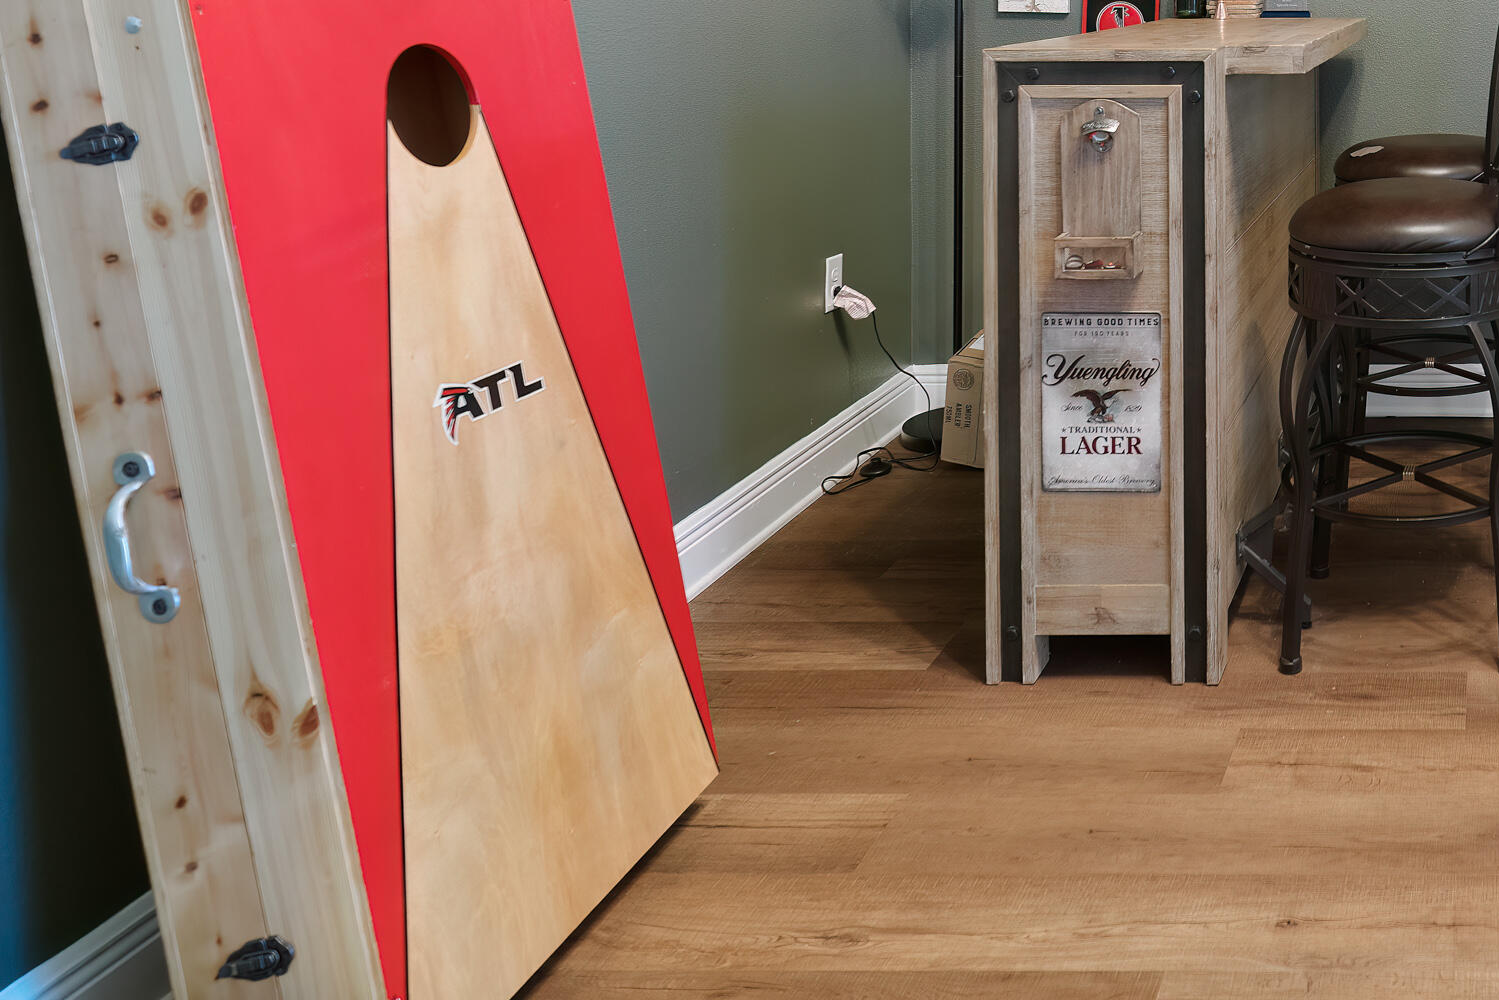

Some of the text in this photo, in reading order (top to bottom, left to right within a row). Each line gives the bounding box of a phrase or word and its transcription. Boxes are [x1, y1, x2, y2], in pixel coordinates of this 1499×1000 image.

[1043, 318, 1159, 326] BREWING GOOD TIMES
[1041, 354, 1161, 387] Yuengling
[436, 361, 545, 444] ATL
[1068, 426, 1136, 434] TRADITIONAL
[1060, 436, 1144, 455] LAGER
